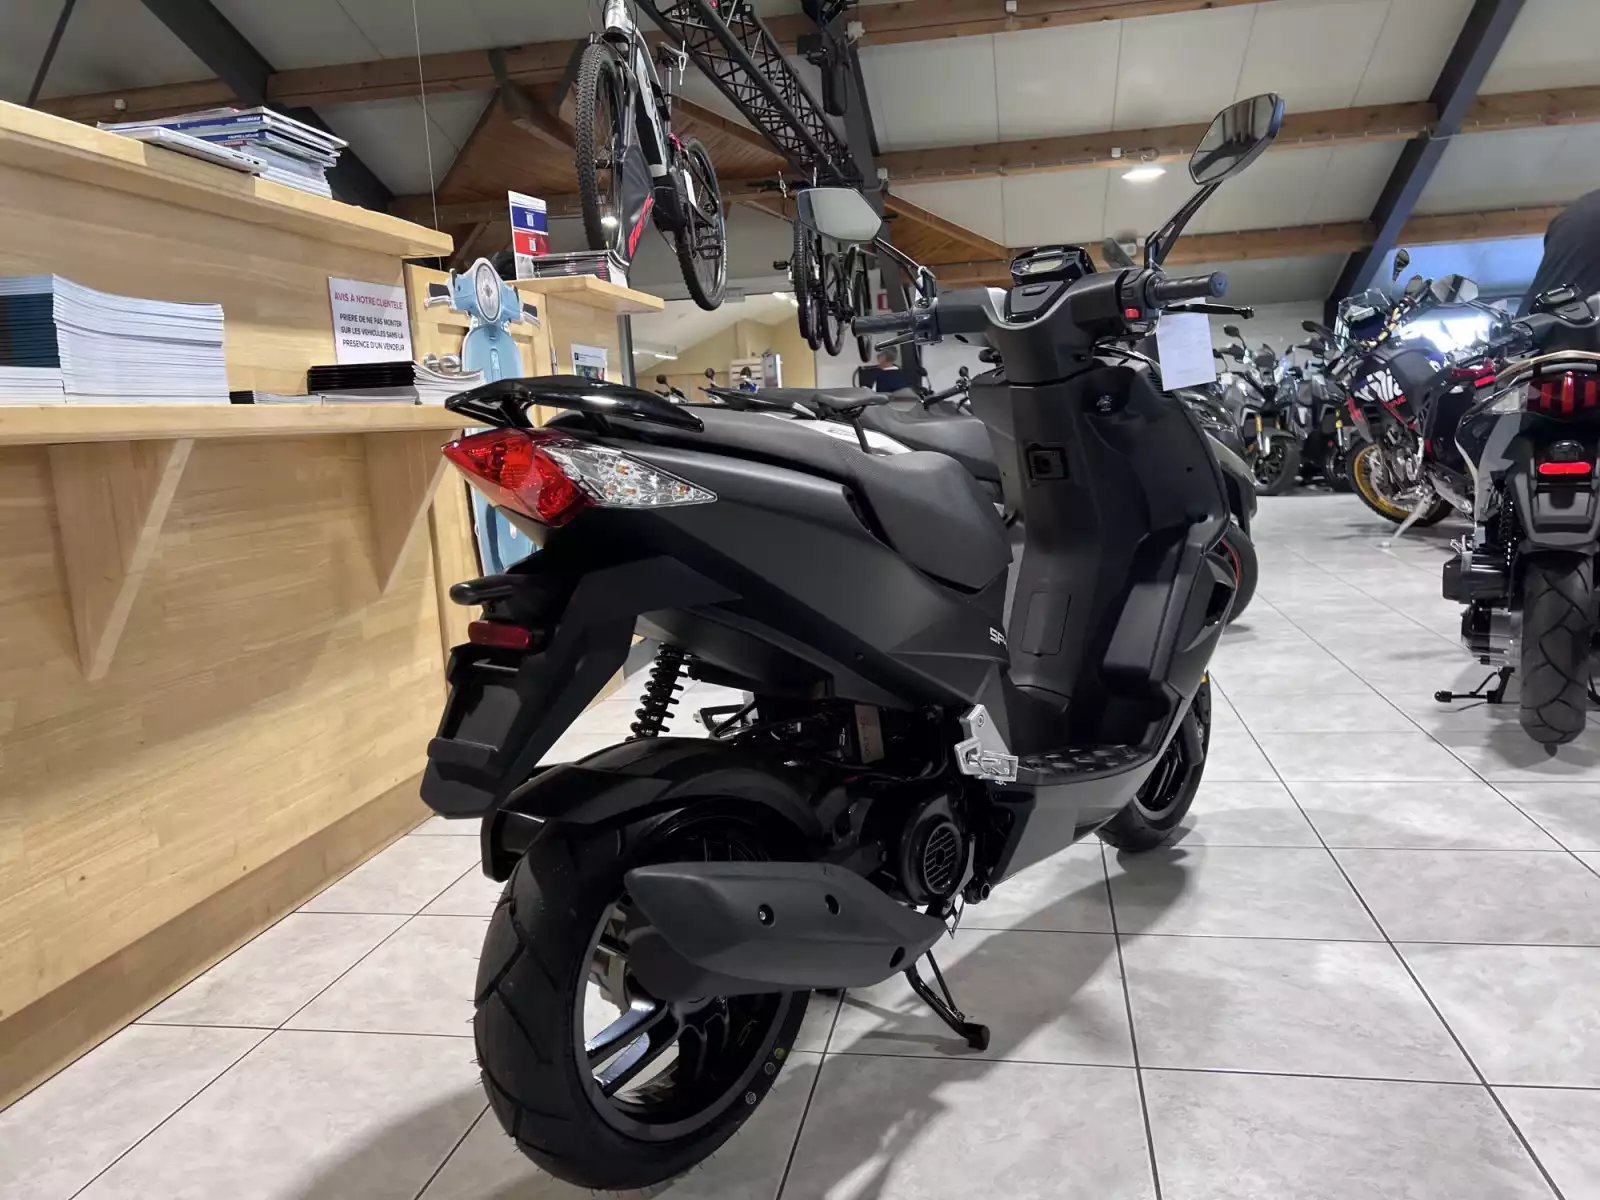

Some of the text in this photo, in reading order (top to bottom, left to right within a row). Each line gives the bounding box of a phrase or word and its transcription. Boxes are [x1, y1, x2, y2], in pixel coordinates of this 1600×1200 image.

[334, 292, 348, 302] AVIS
[356, 295, 376, 306] NOTRE
[359, 315, 366, 324] DE
[374, 317, 383, 326] PAS
[384, 320, 402, 328] MONTER
[370, 342, 383, 350] D'UN
[383, 343, 404, 351] VENDEUR
